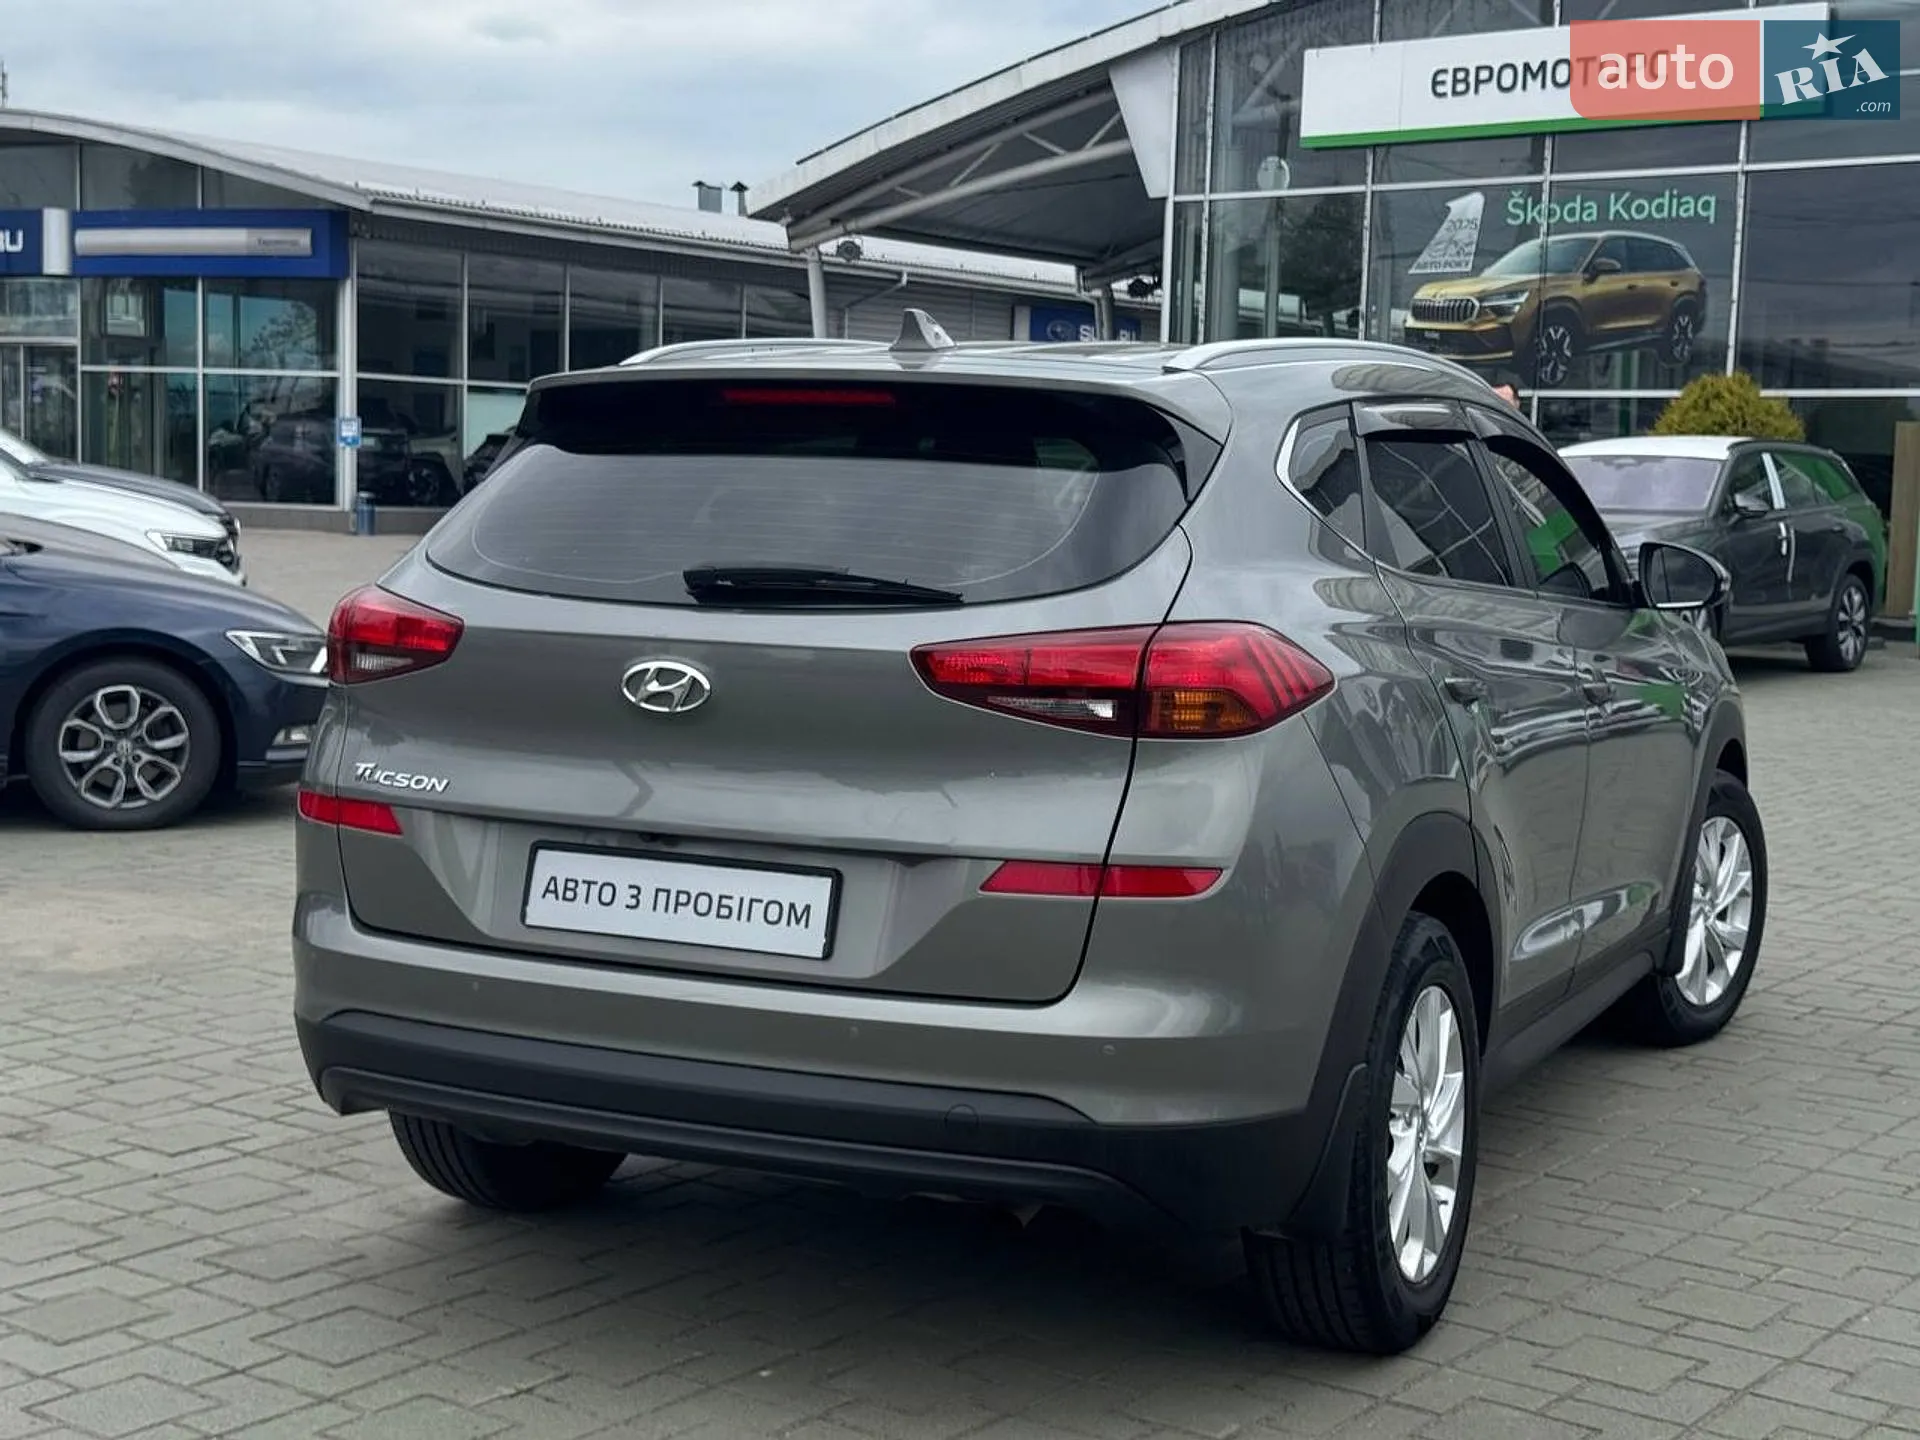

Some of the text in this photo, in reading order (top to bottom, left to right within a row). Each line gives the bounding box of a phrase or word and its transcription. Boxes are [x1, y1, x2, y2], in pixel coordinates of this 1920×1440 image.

[1506, 189, 1716, 226] Škoda Kodiaq
[356, 762, 450, 793] TUCSON
[542, 875, 617, 908] АВТО
[652, 887, 812, 930] ПРОБІГОМ
